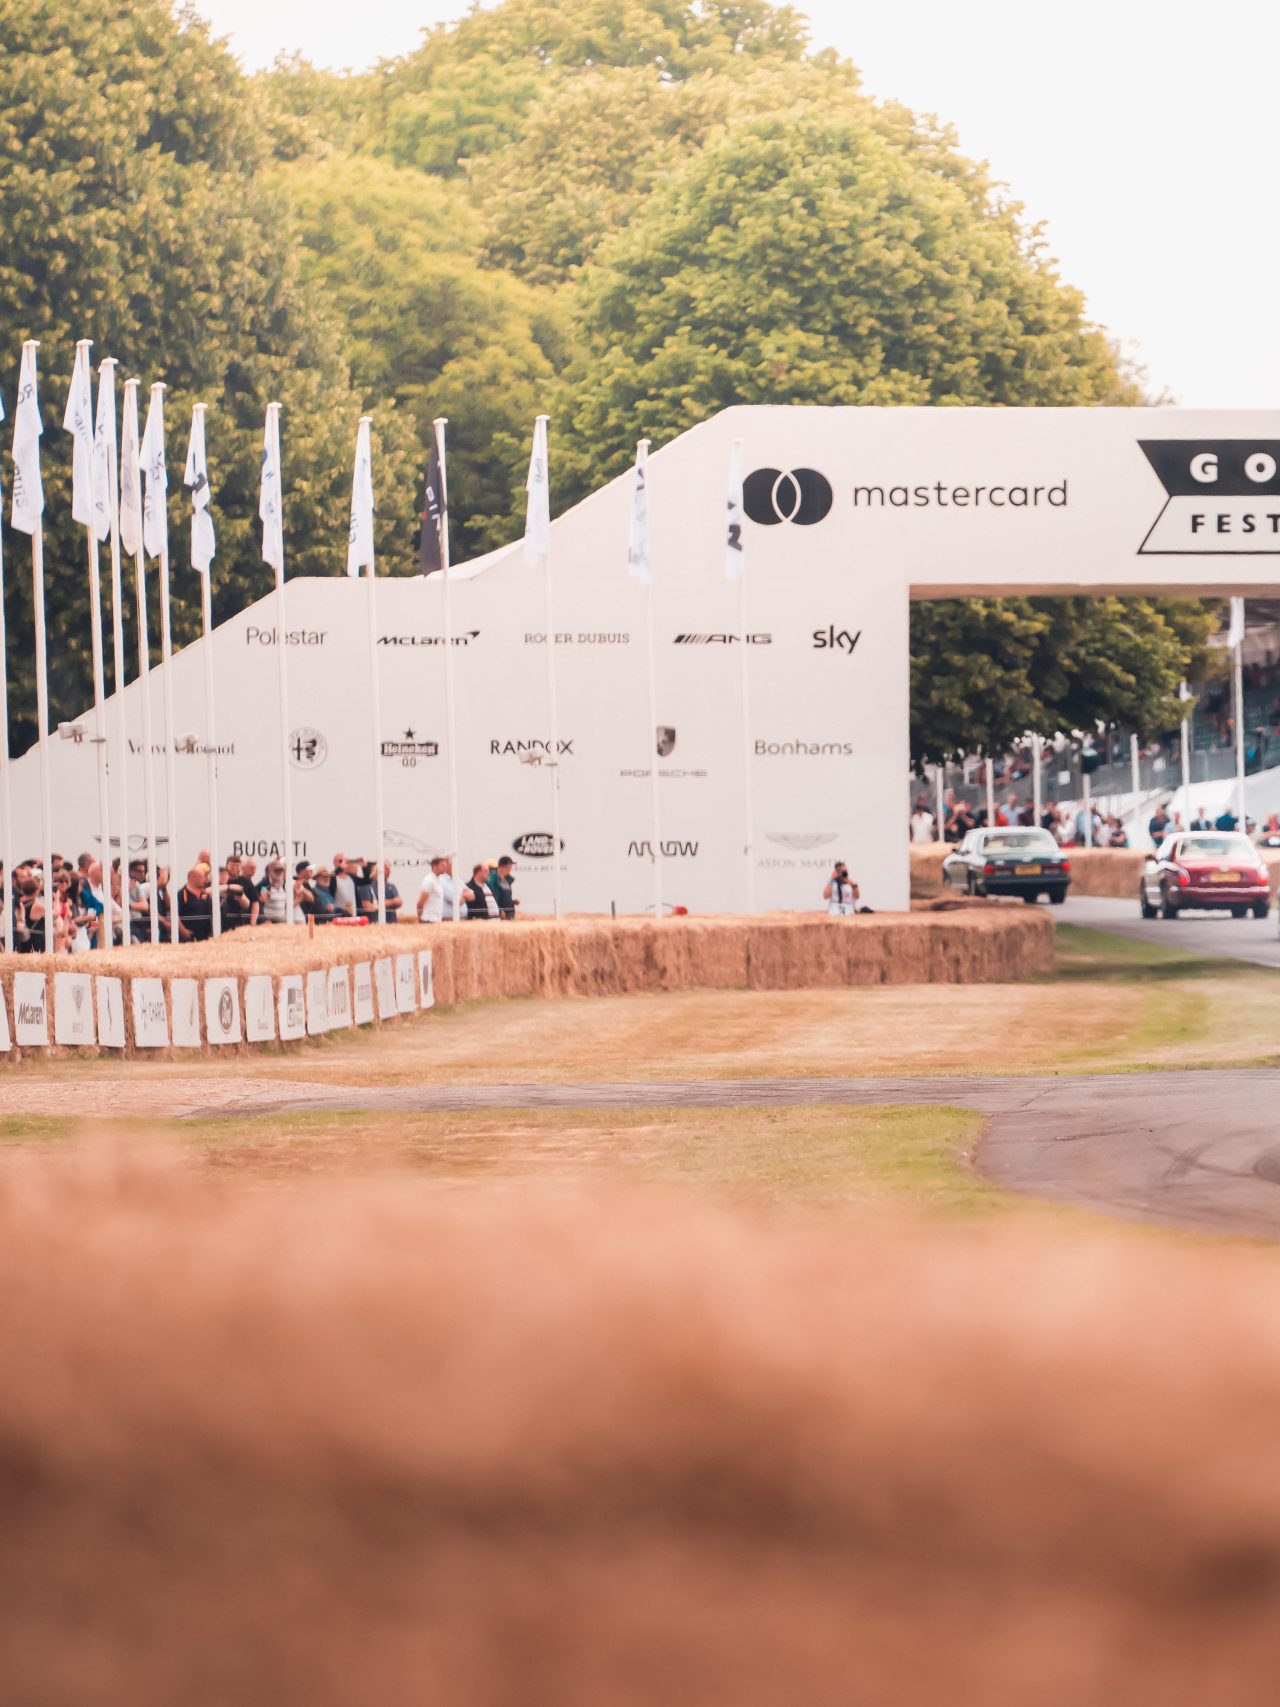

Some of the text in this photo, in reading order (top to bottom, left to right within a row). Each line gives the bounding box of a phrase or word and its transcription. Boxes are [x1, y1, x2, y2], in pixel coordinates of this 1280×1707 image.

[853, 479, 1069, 507] mastercard
[578, 633, 630, 644] DUBUIS
[813, 625, 862, 655] sky
[754, 739, 853, 756] Bonhams
